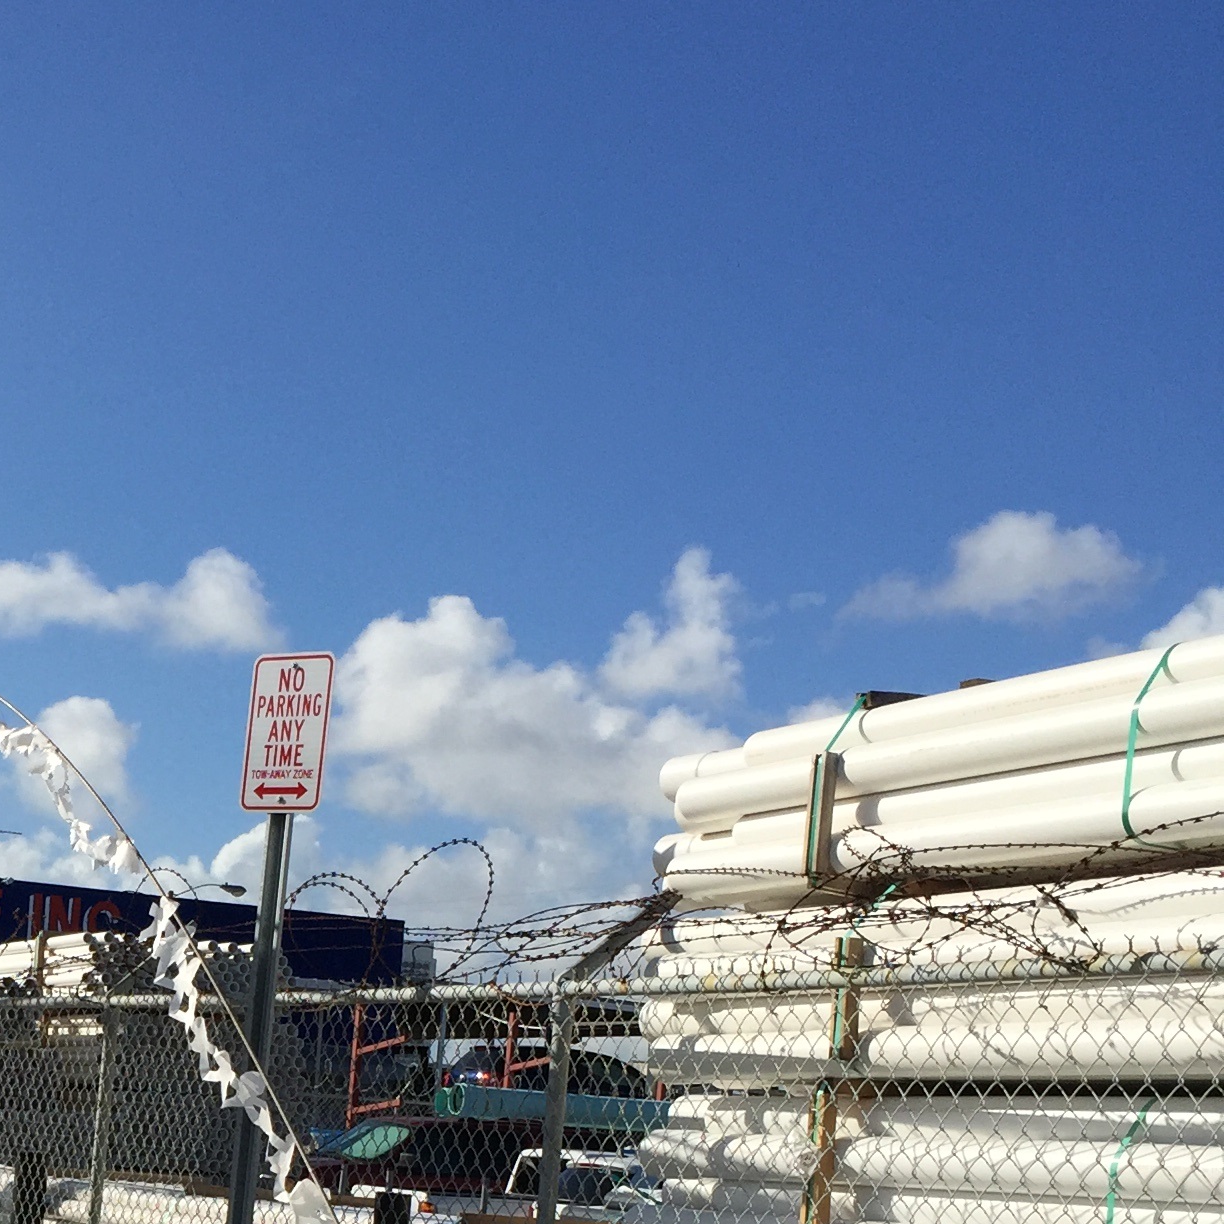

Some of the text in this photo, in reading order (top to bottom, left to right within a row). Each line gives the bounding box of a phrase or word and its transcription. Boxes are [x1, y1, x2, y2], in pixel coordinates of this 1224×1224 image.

[278, 667, 305, 692] NO
[257, 693, 323, 718] PARKING
[267, 719, 306, 743] ANY
[264, 744, 304, 767] TIME
[251, 769, 314, 780] TOW-AWAY ZONE
